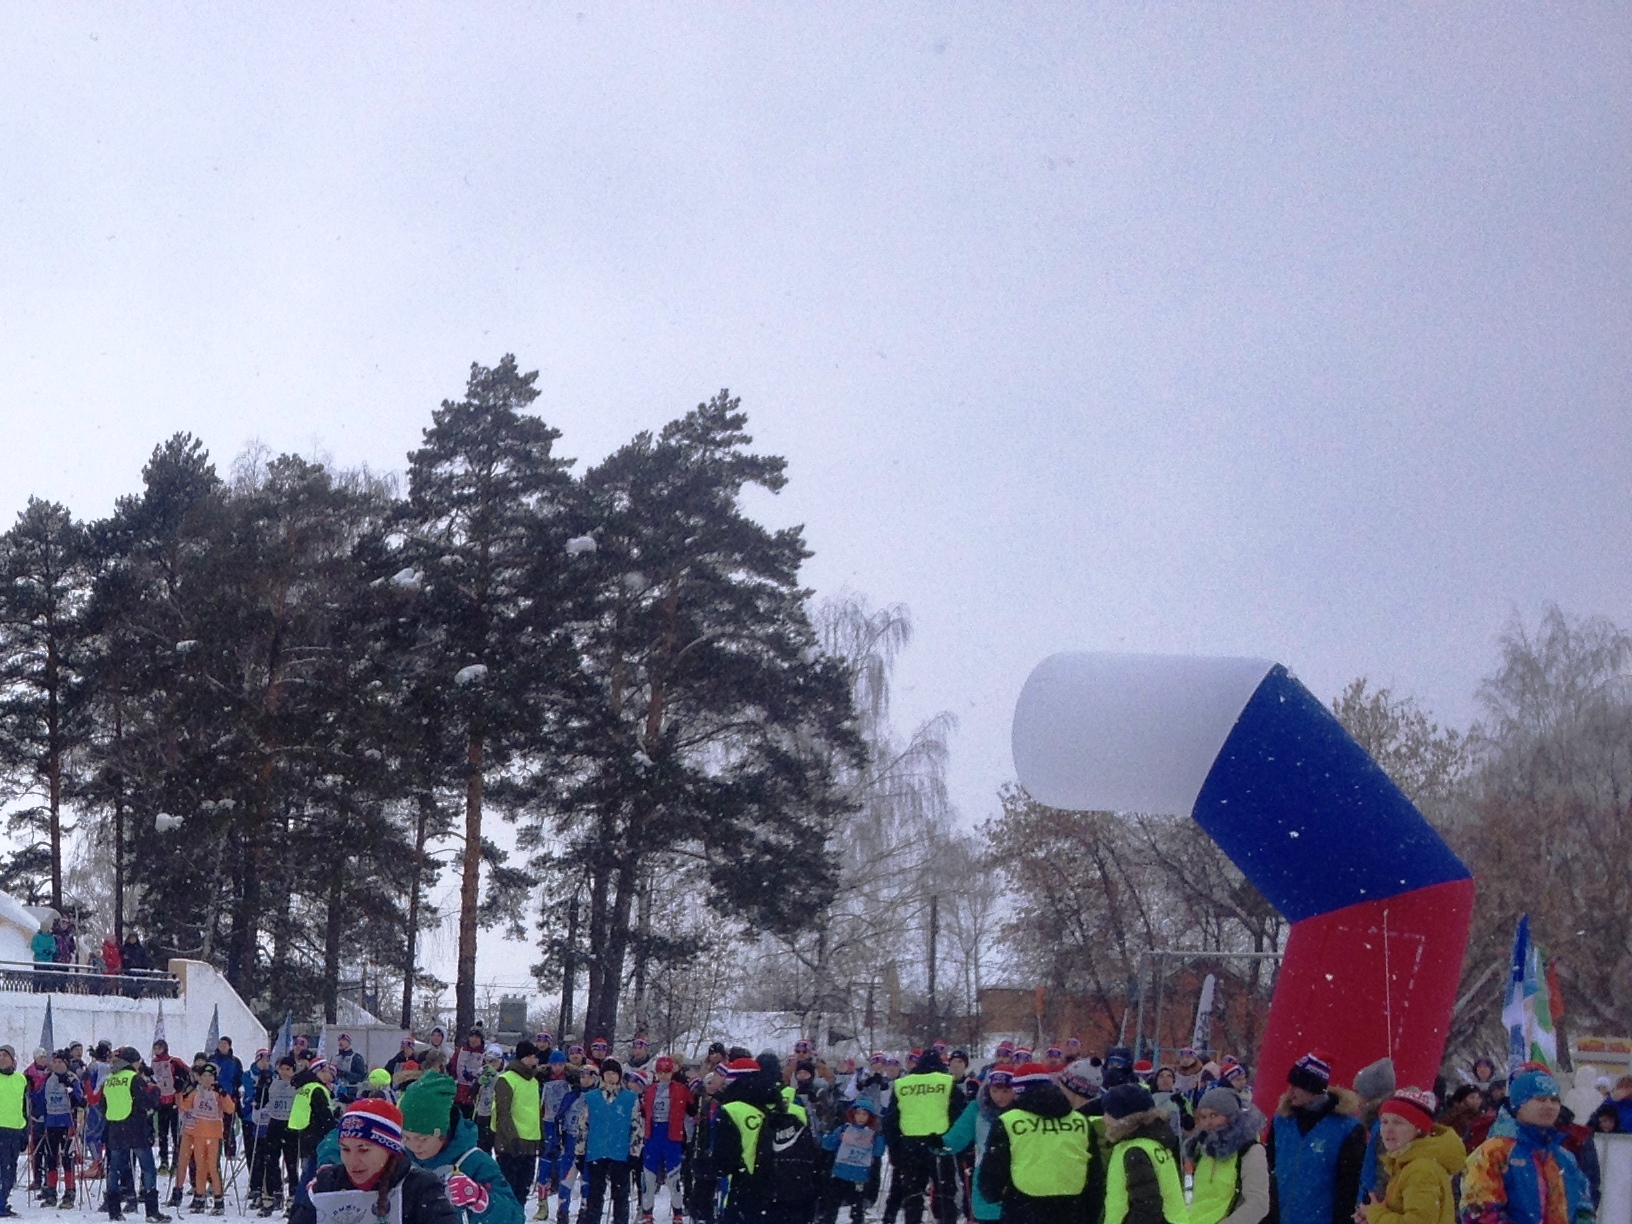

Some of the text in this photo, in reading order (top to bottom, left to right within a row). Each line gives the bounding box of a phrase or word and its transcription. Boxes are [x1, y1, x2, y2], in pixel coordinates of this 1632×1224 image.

[105, 1076, 129, 1087] УДЬЯ
[899, 1083, 945, 1096] СУДЬЯ
[1011, 1117, 1086, 1136] СУДЬЯ
